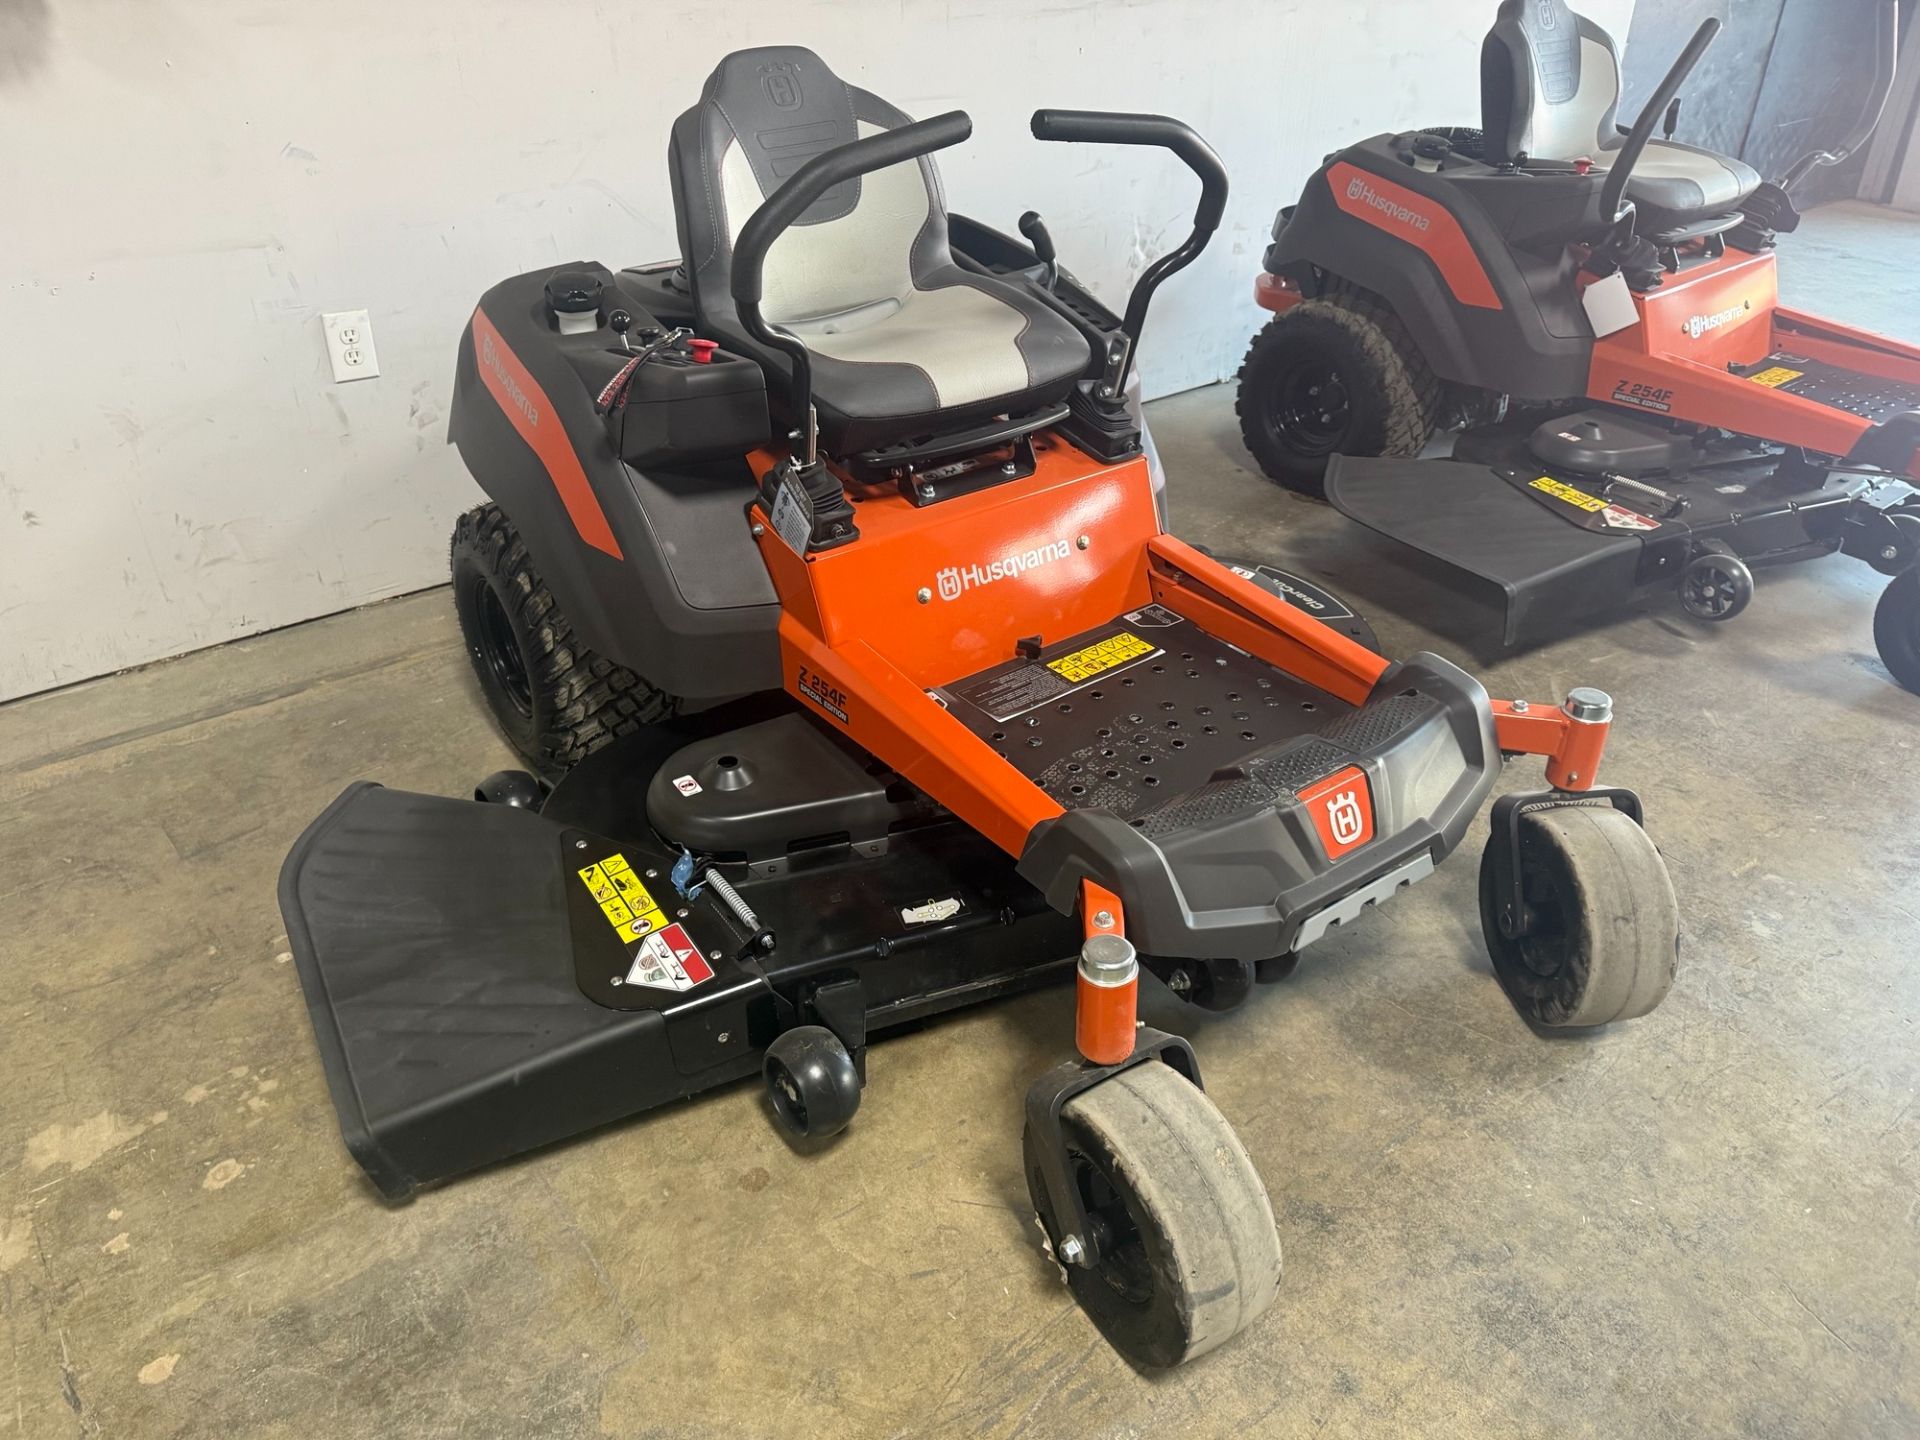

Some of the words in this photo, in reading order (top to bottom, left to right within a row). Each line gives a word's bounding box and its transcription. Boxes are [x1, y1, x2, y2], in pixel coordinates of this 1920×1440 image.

[1360, 185, 1430, 231] Husqvarna
[491, 345, 538, 427] Husqvarna
[1616, 380, 1628, 392] Z
[1630, 383, 1674, 402] 254F
[1642, 399, 1669, 411] EDITION
[961, 539, 1071, 591] Husqvarna
[799, 664, 807, 683] Z
[811, 674, 847, 708] 254F
[800, 683, 823, 705] SPECIAL
[823, 700, 847, 722] EDITION
